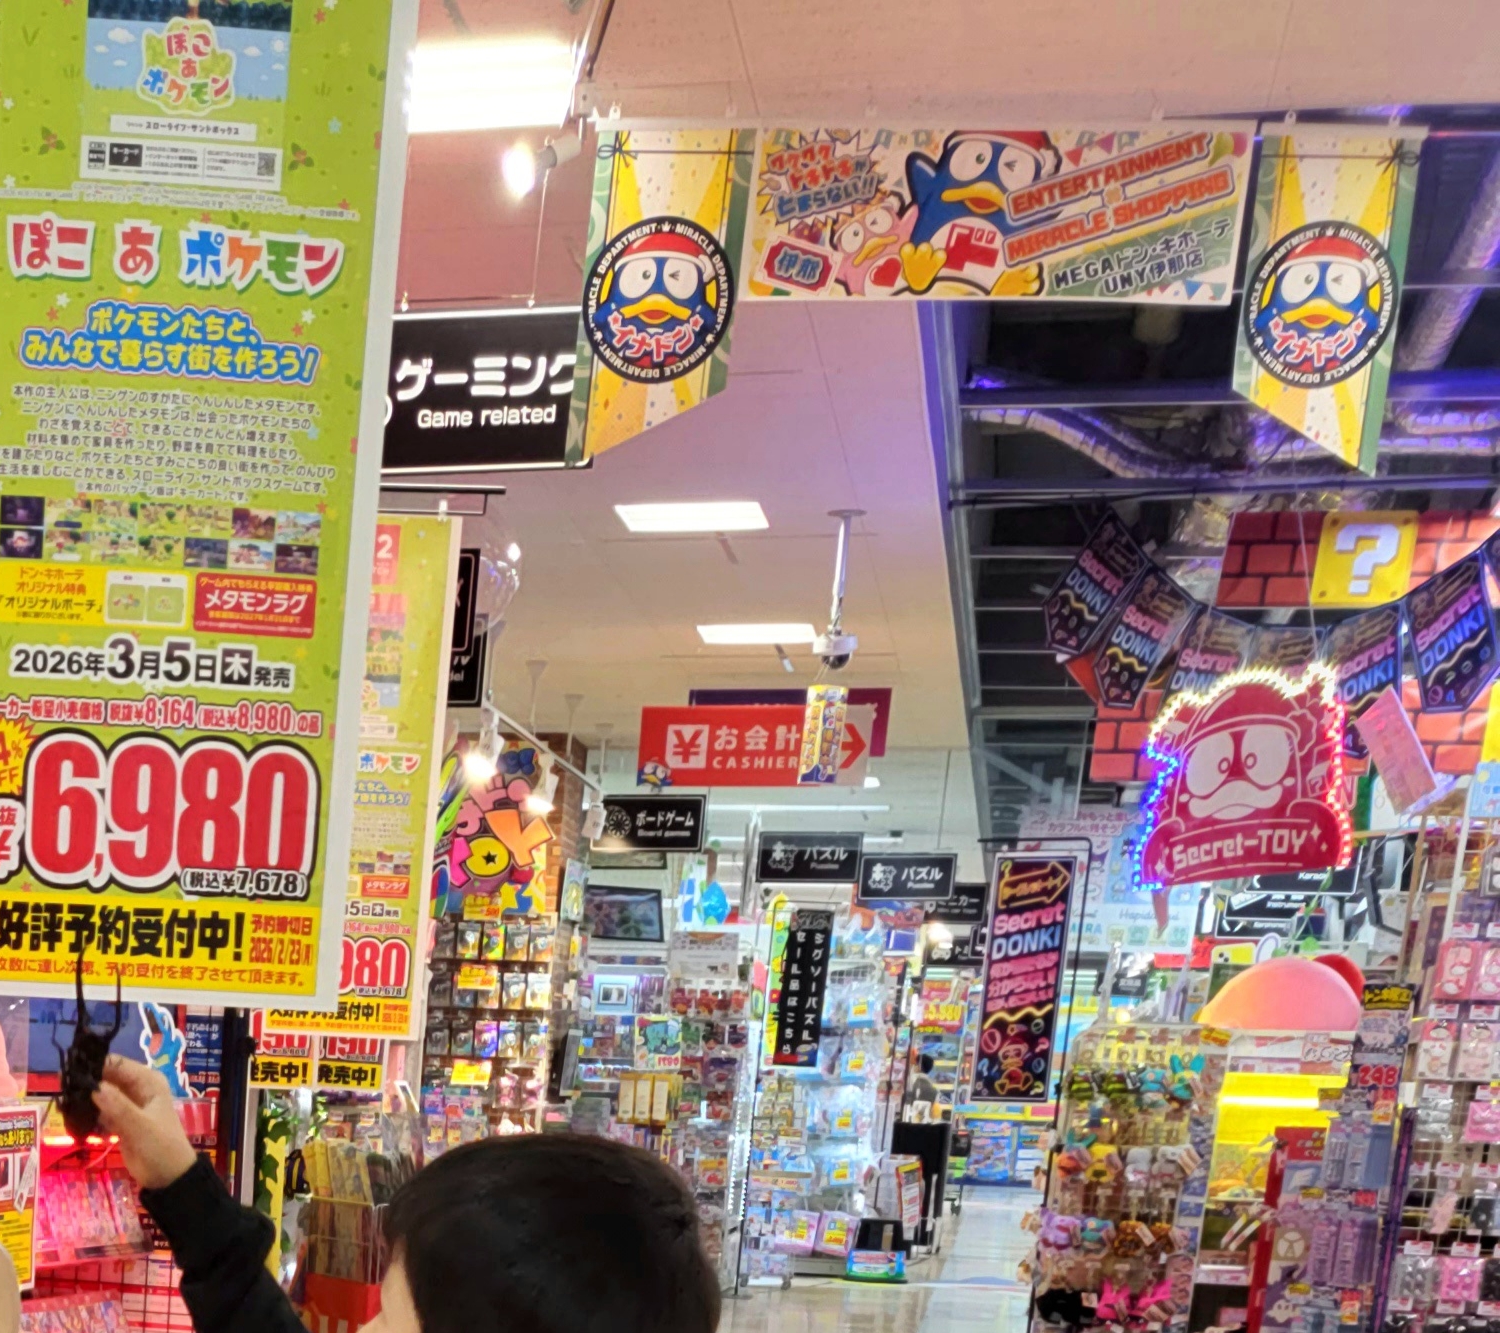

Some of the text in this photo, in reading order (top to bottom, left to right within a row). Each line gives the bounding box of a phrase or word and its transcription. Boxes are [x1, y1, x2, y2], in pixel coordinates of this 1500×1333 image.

[142, 68, 231, 105] ポケモン
[180, 59, 198, 79] あ
[1011, 133, 1209, 218] ENTERTAINMENT
[1007, 170, 1231, 263] MIRACLE SHOPPING
[11, 216, 342, 289] ぽこ あ ポケモン
[597, 223, 658, 275] DEPARTMENT
[1053, 218, 1231, 290] MEGAドン・キホーテ
[1259, 226, 1322, 286] DEPARTMENT
[675, 223, 729, 333] MIRACLE DEPARTMENT
[1103, 251, 1204, 294] UNY伊那店
[1339, 228, 1395, 337] MIRACLE DEPARTMENT
[90, 306, 258, 341] ポケモンたちと、
[23, 328, 318, 381] みんなで暮らす街を作ろう!
[599, 344, 707, 378] MIRACLE DEPARTMENT
[612, 323, 695, 362] イナドン
[1272, 323, 1363, 366] イナドン
[1258, 347, 1373, 385] MIRACLE DEPARTMENT
[417, 404, 556, 429] Game related
[16, 581, 86, 596] オリジナル特典
[20, 567, 85, 580] ドン・キホーテ
[204, 589, 308, 615] メタモンラグ
[1416, 583, 1481, 653] Secret
[1337, 635, 1395, 681] ecret
[1421, 605, 1486, 675] DONKI
[713, 725, 800, 751] お会計
[359, 753, 418, 772] ポケモン
[712, 754, 800, 769] CASHIER
[31, 739, 310, 877] 6,980
[636, 810, 694, 827] ボードゲーム
[804, 847, 849, 861] パズル
[1171, 828, 1308, 868] Secret-TOY
[365, 879, 408, 892] メタモンラグ
[901, 866, 944, 881] パズル
[251, 914, 312, 936] 予約締切日
[993, 902, 1066, 936] Secret
[991, 925, 1062, 961] DONKI
[782, 931, 807, 1055] セール品はこちら
[318, 1063, 377, 1087] 発売中!
